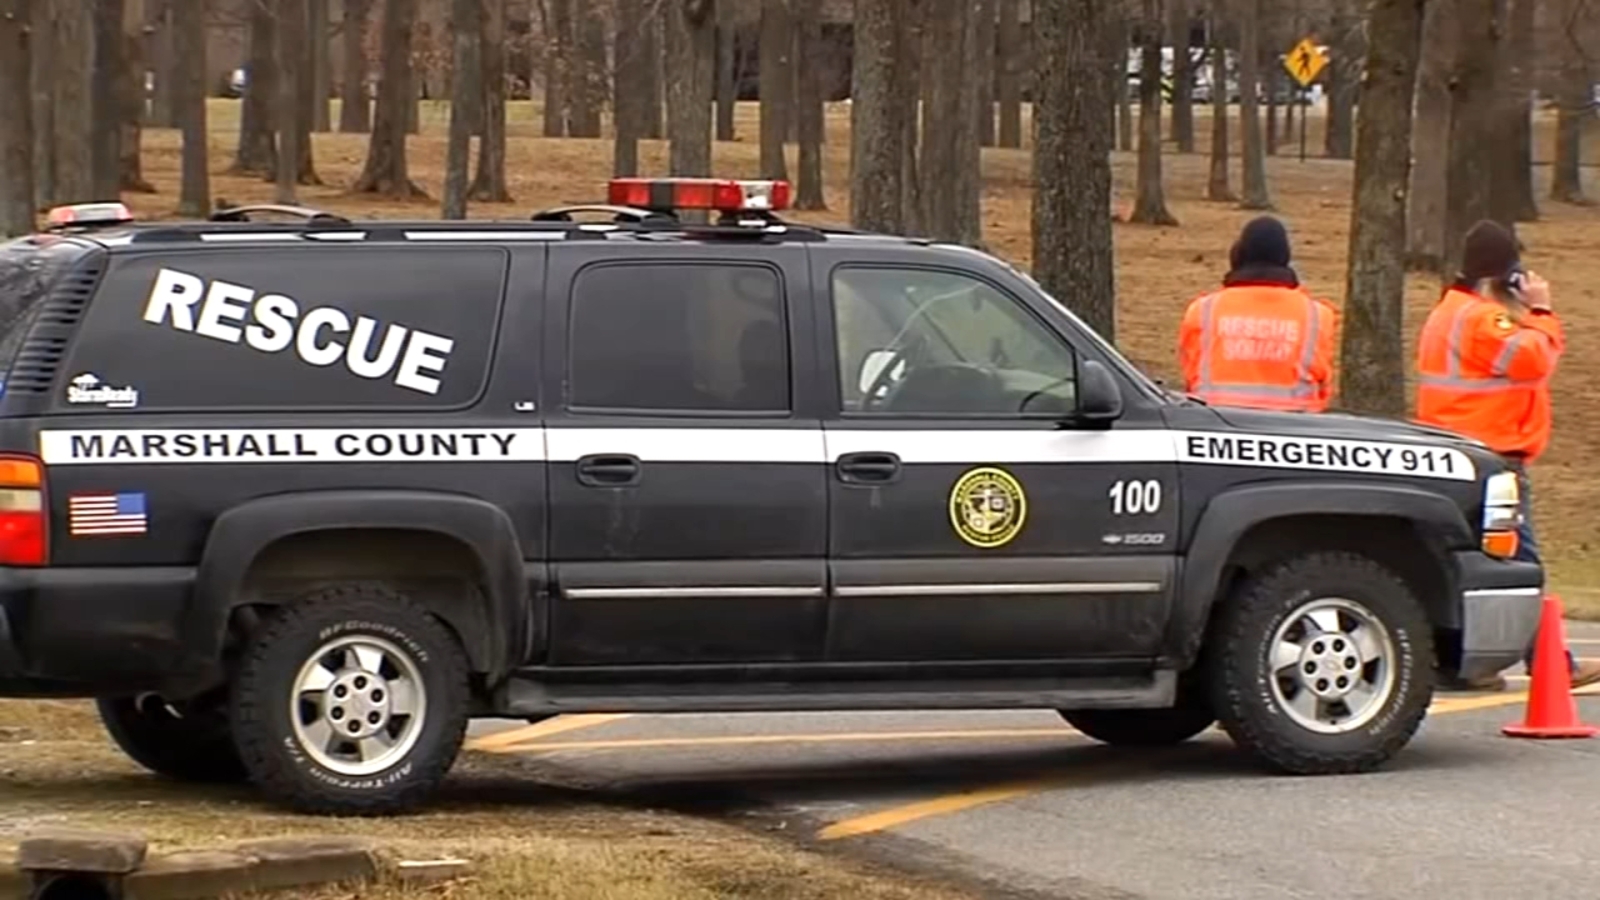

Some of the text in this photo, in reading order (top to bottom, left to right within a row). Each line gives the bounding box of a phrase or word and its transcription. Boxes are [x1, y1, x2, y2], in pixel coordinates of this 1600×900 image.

[143, 268, 454, 395] RESCUE
[1217, 316, 1299, 342] RESCUE
[70, 433, 517, 458] MARSHALL COUNTY
[1186, 436, 1454, 473] EMERGENCY 911
[1109, 480, 1162, 514] 100
